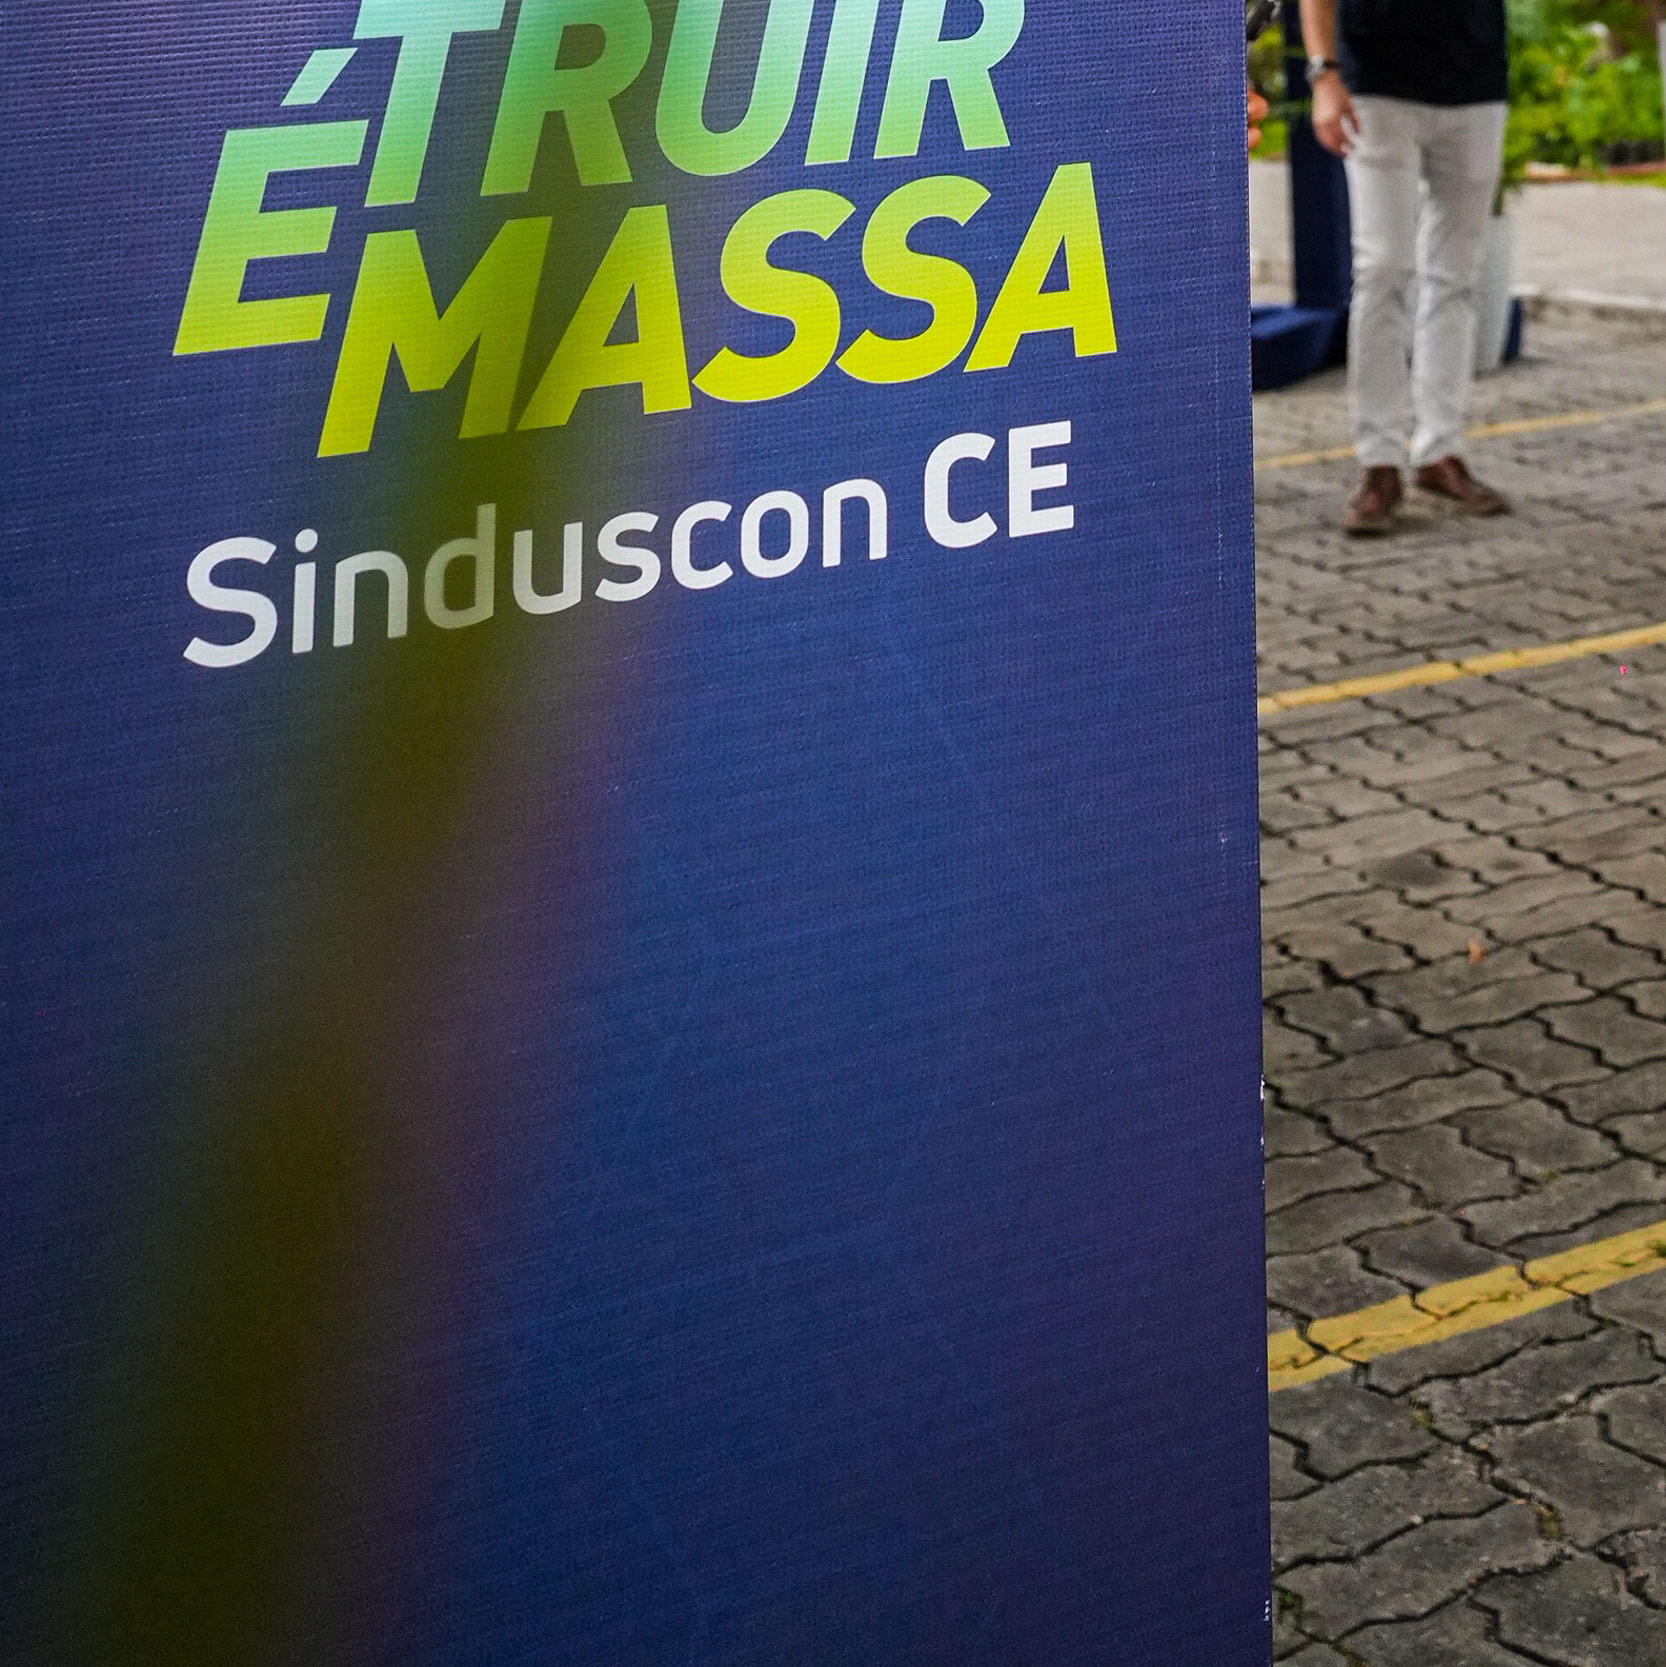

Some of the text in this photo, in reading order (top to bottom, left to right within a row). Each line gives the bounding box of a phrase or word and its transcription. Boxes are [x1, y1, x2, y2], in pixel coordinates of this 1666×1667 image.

[172, 46, 1117, 459] É MASSA
[183, 420, 1075, 668] Sinduscon CE
